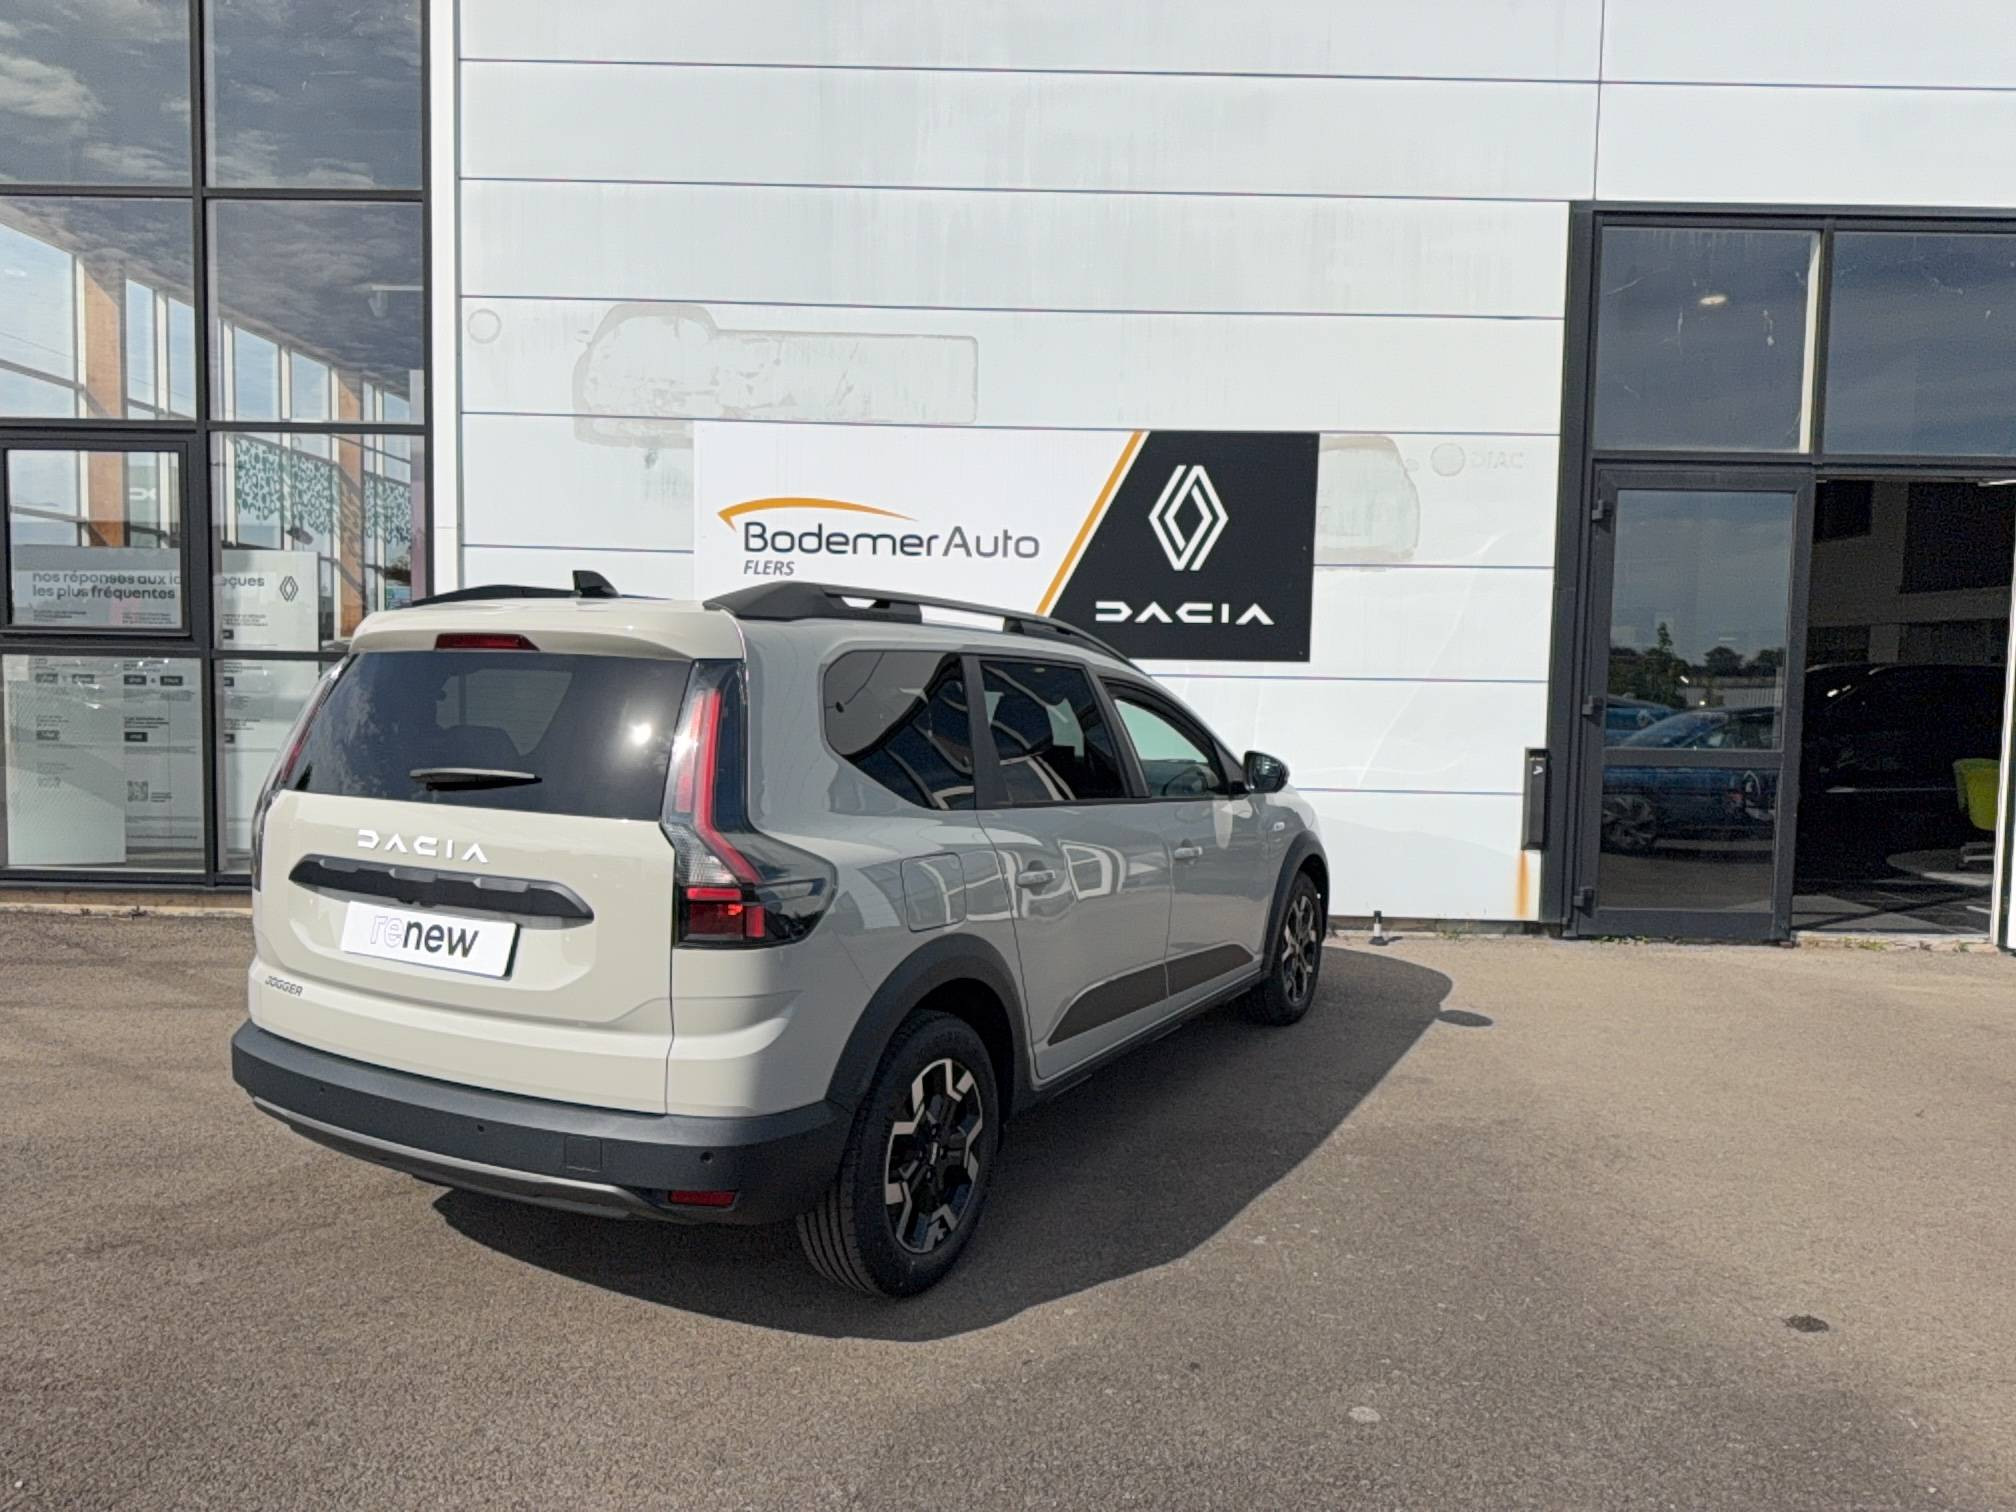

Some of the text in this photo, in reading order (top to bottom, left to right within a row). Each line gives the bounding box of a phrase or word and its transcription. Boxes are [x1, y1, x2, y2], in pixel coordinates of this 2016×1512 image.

[32, 571, 60, 583] nos
[63, 569, 134, 586] réponses
[137, 574, 166, 586] aux
[743, 559, 796, 577] FLERS
[32, 583, 176, 602] les plus fréquentes
[1095, 600, 1275, 626] DACIA
[357, 828, 489, 864] DACIA
[369, 915, 480, 958] renew
[264, 975, 304, 997] JOGGER
